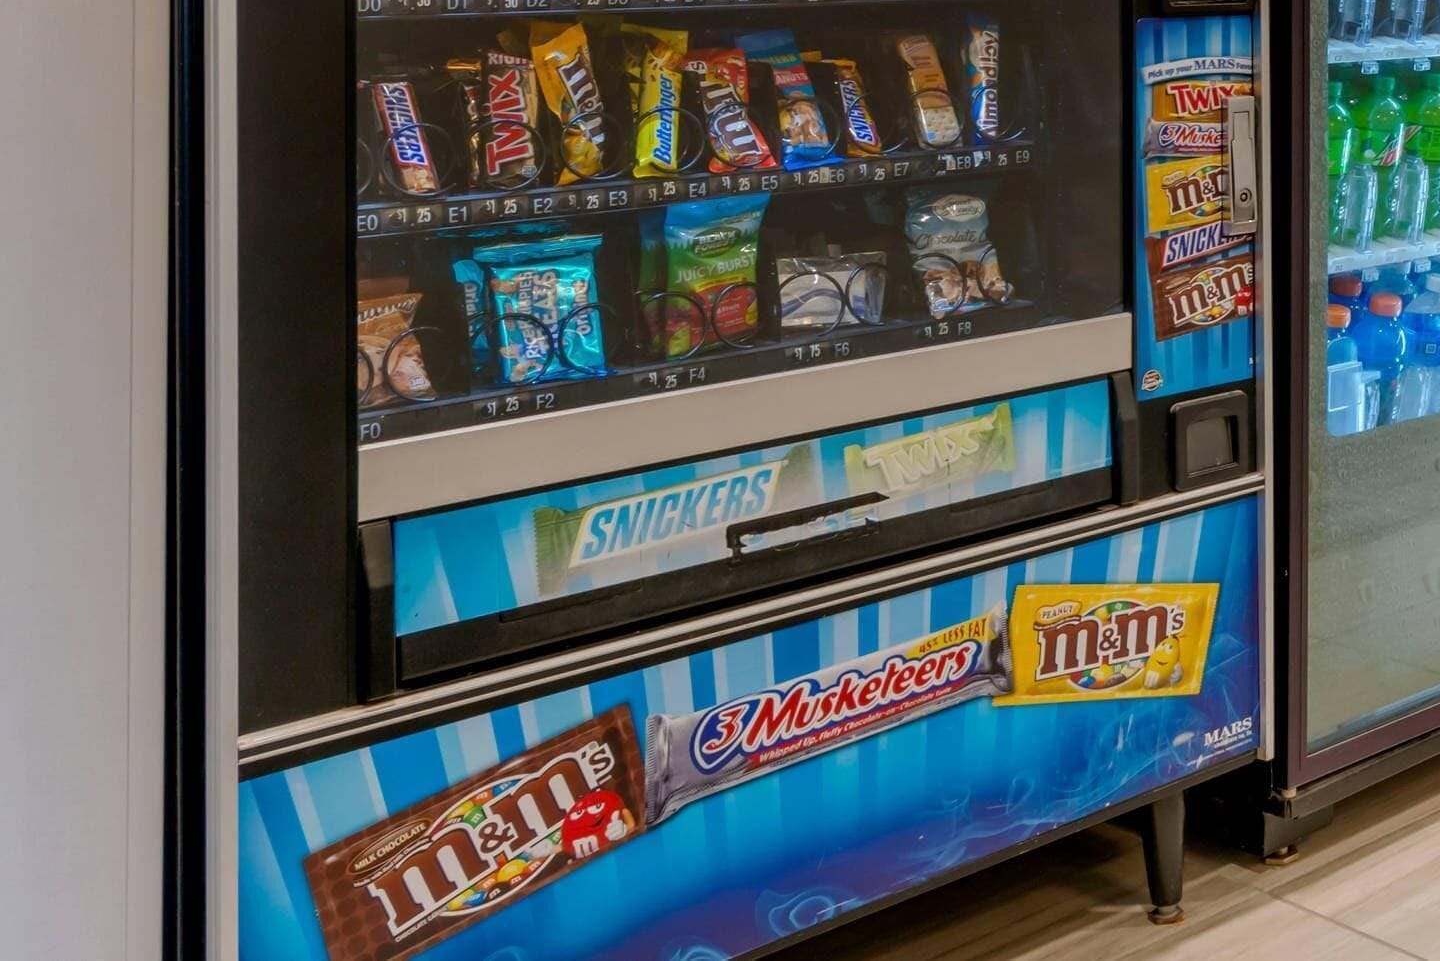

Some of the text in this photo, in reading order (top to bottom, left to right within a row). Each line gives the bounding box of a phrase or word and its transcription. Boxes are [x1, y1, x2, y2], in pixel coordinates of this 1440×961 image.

[1148, 68, 1163, 79] Pick
[1165, 68, 1174, 77] up
[1176, 65, 1193, 75] your
[1194, 58, 1236, 70] MARS
[383, 82, 425, 164] SNICKERS
[957, 156, 971, 169] E8
[1016, 151, 1030, 163] E9
[829, 169, 845, 183] E6
[894, 163, 909, 176] E7
[689, 183, 706, 197] E4
[761, 176, 778, 189] E5
[534, 198, 552, 213] E2
[609, 191, 628, 206] E3
[449, 206, 467, 222] E1
[357, 216, 378, 232] E0
[676, 254, 756, 283] JUICY BURST
[958, 322, 971, 335] F8
[835, 342, 849, 356] F6
[689, 368, 705, 382] F4
[536, 394, 554, 409] F2
[360, 423, 380, 441] F0
[582, 468, 772, 560] SNICKERS
[1042, 604, 1074, 620] PEANUT
[943, 627, 965, 644] LESS
[968, 618, 987, 637] FAT
[701, 646, 970, 754] 3 Musketeers
[1203, 716, 1253, 747] MARS
[759, 740, 802, 763] Whipped
[819, 725, 842, 741] Fluffy
[354, 853, 377, 870] MILK
[376, 822, 427, 857] CHOCOLATE
